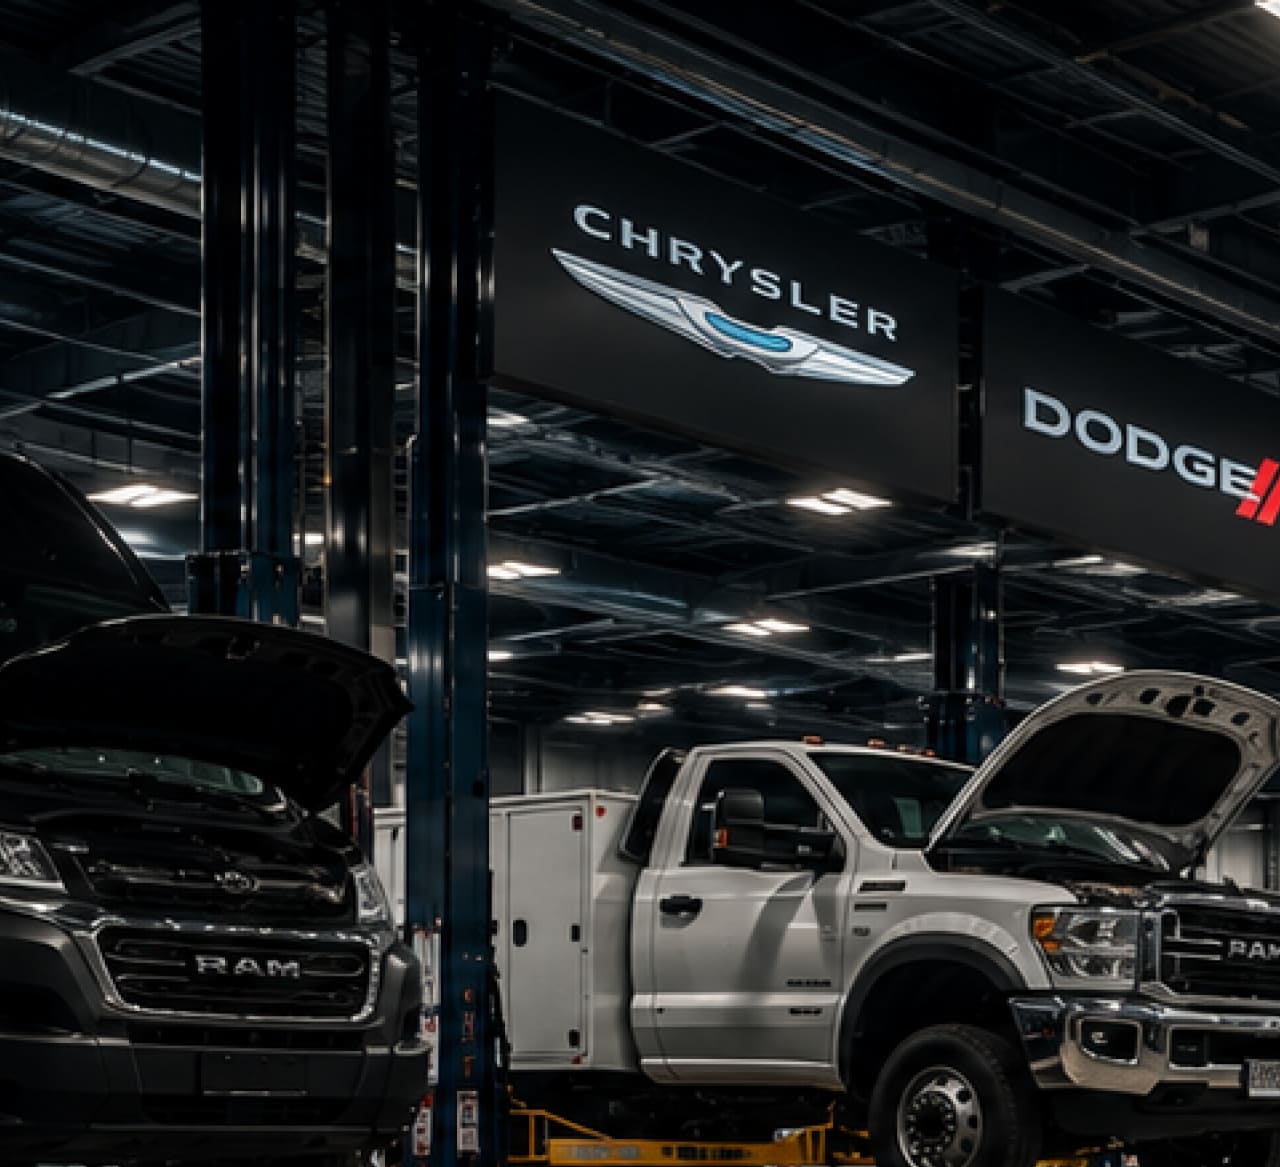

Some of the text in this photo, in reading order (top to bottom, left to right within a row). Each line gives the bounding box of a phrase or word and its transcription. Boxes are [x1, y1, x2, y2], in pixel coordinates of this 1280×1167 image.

[573, 204, 898, 342] CHRYSLER
[1024, 385, 1262, 503] DODGE
[194, 954, 300, 979] RAM
